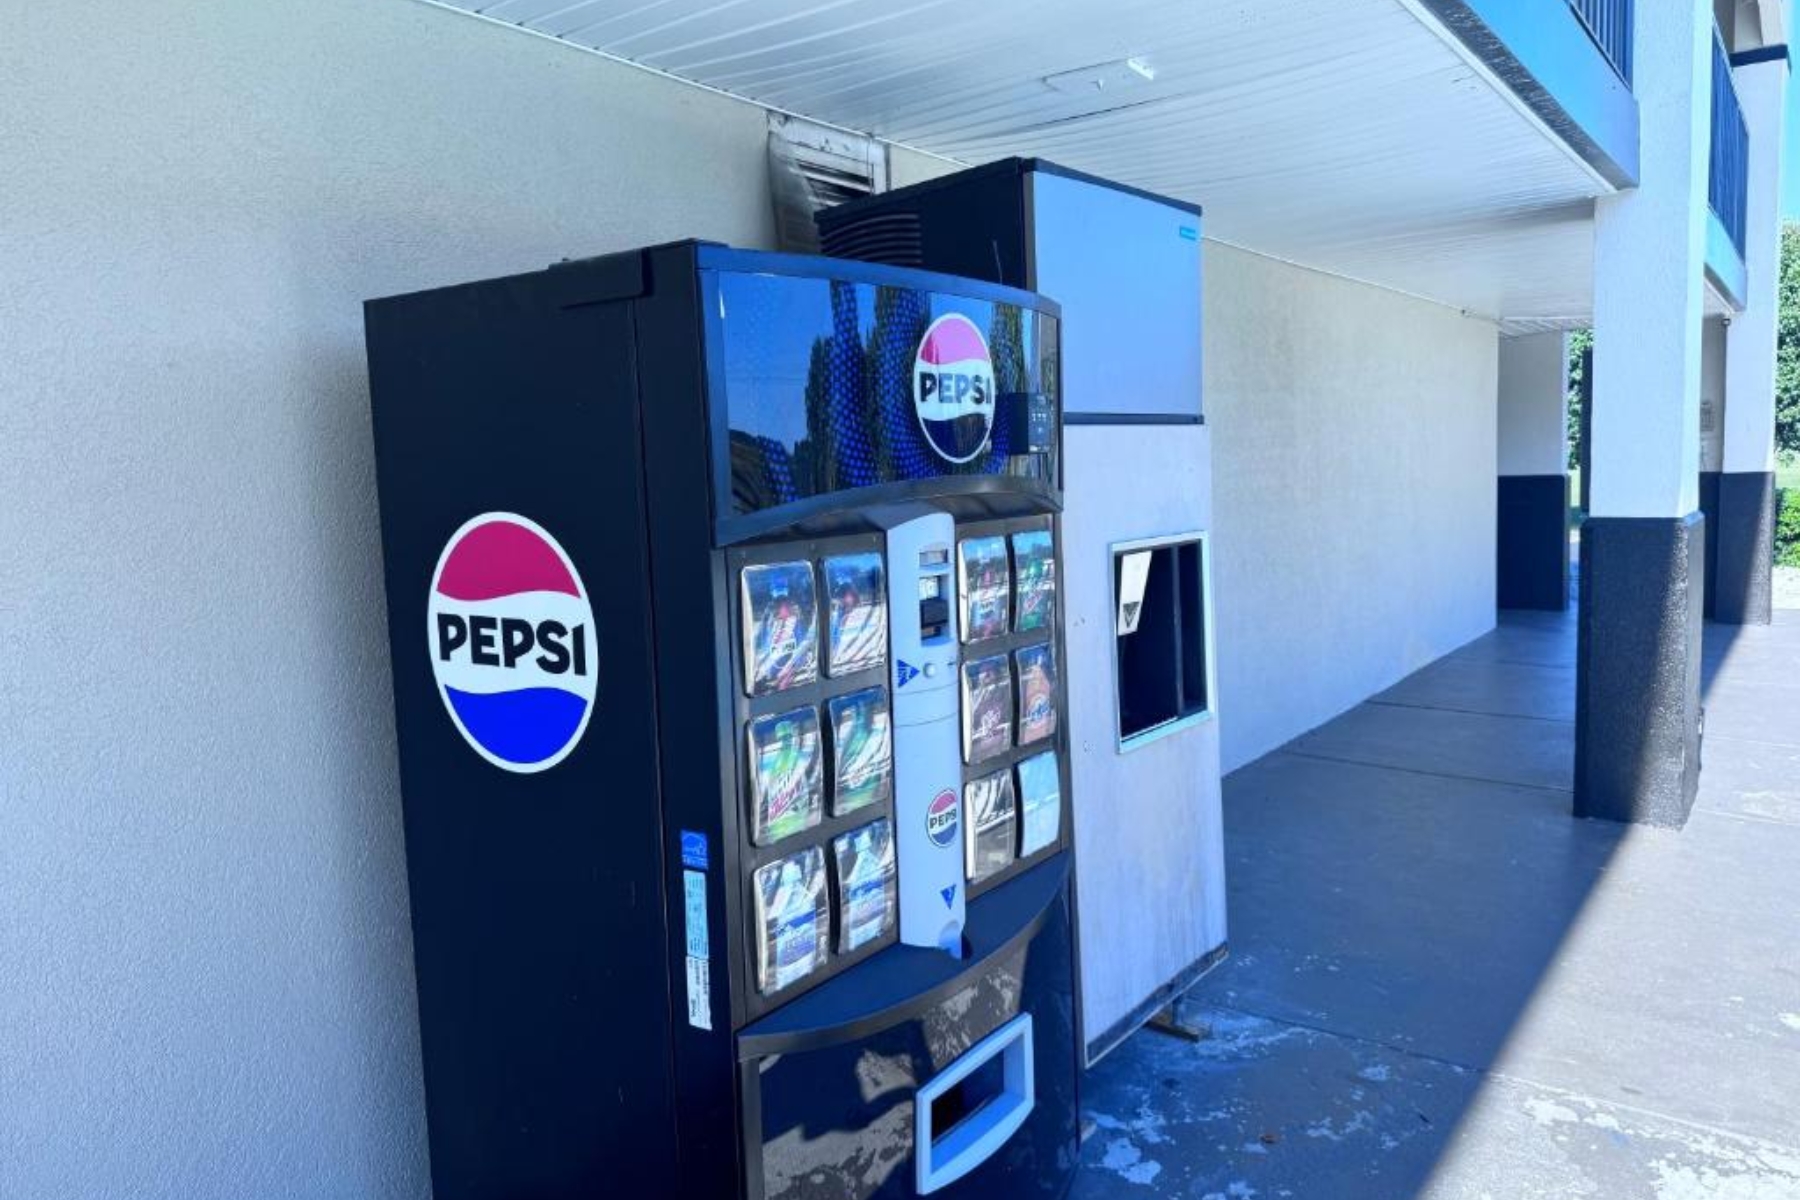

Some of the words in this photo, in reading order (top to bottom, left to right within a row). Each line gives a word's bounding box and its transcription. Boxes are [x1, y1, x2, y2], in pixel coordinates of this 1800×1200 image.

[919, 371, 992, 406] PEPSI
[437, 612, 587, 676] PEPSI
[929, 808, 957, 829] PEPS
